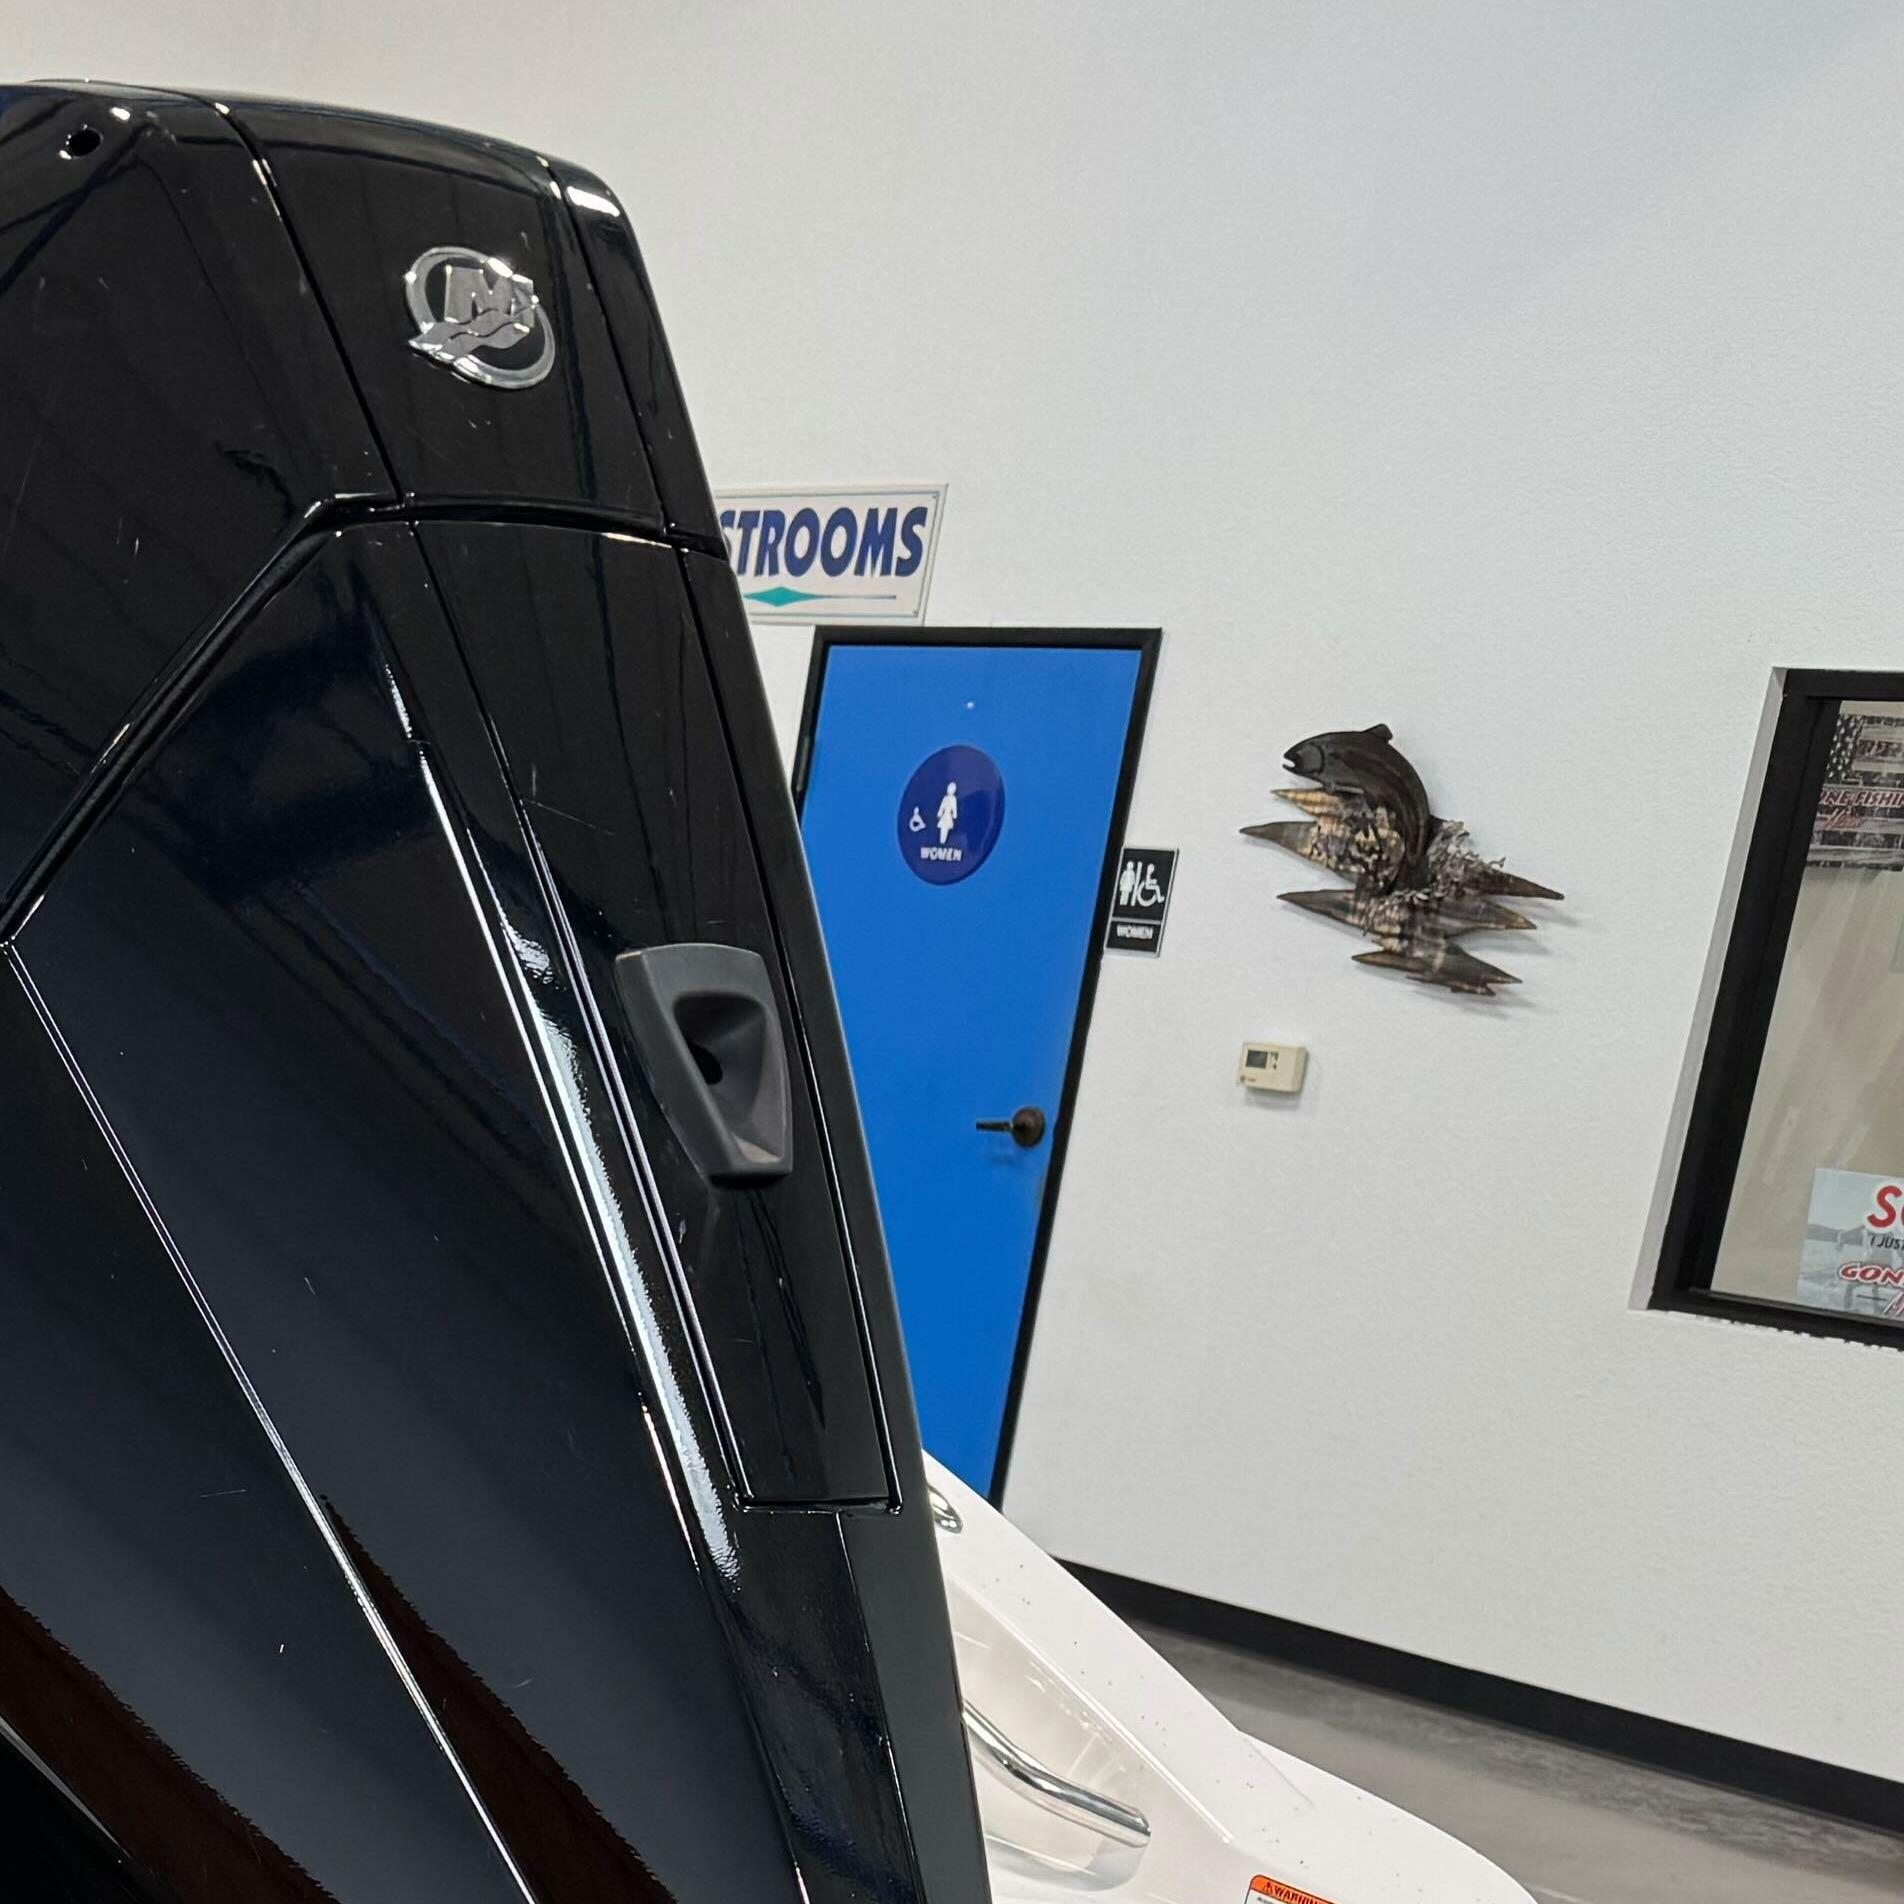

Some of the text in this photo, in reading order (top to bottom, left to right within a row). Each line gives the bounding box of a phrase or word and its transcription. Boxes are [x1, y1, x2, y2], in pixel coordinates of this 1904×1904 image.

[920, 846, 962, 862] WOMEN
[1115, 925, 1154, 940] WOMEN
[1867, 1185, 1904, 1229] S
